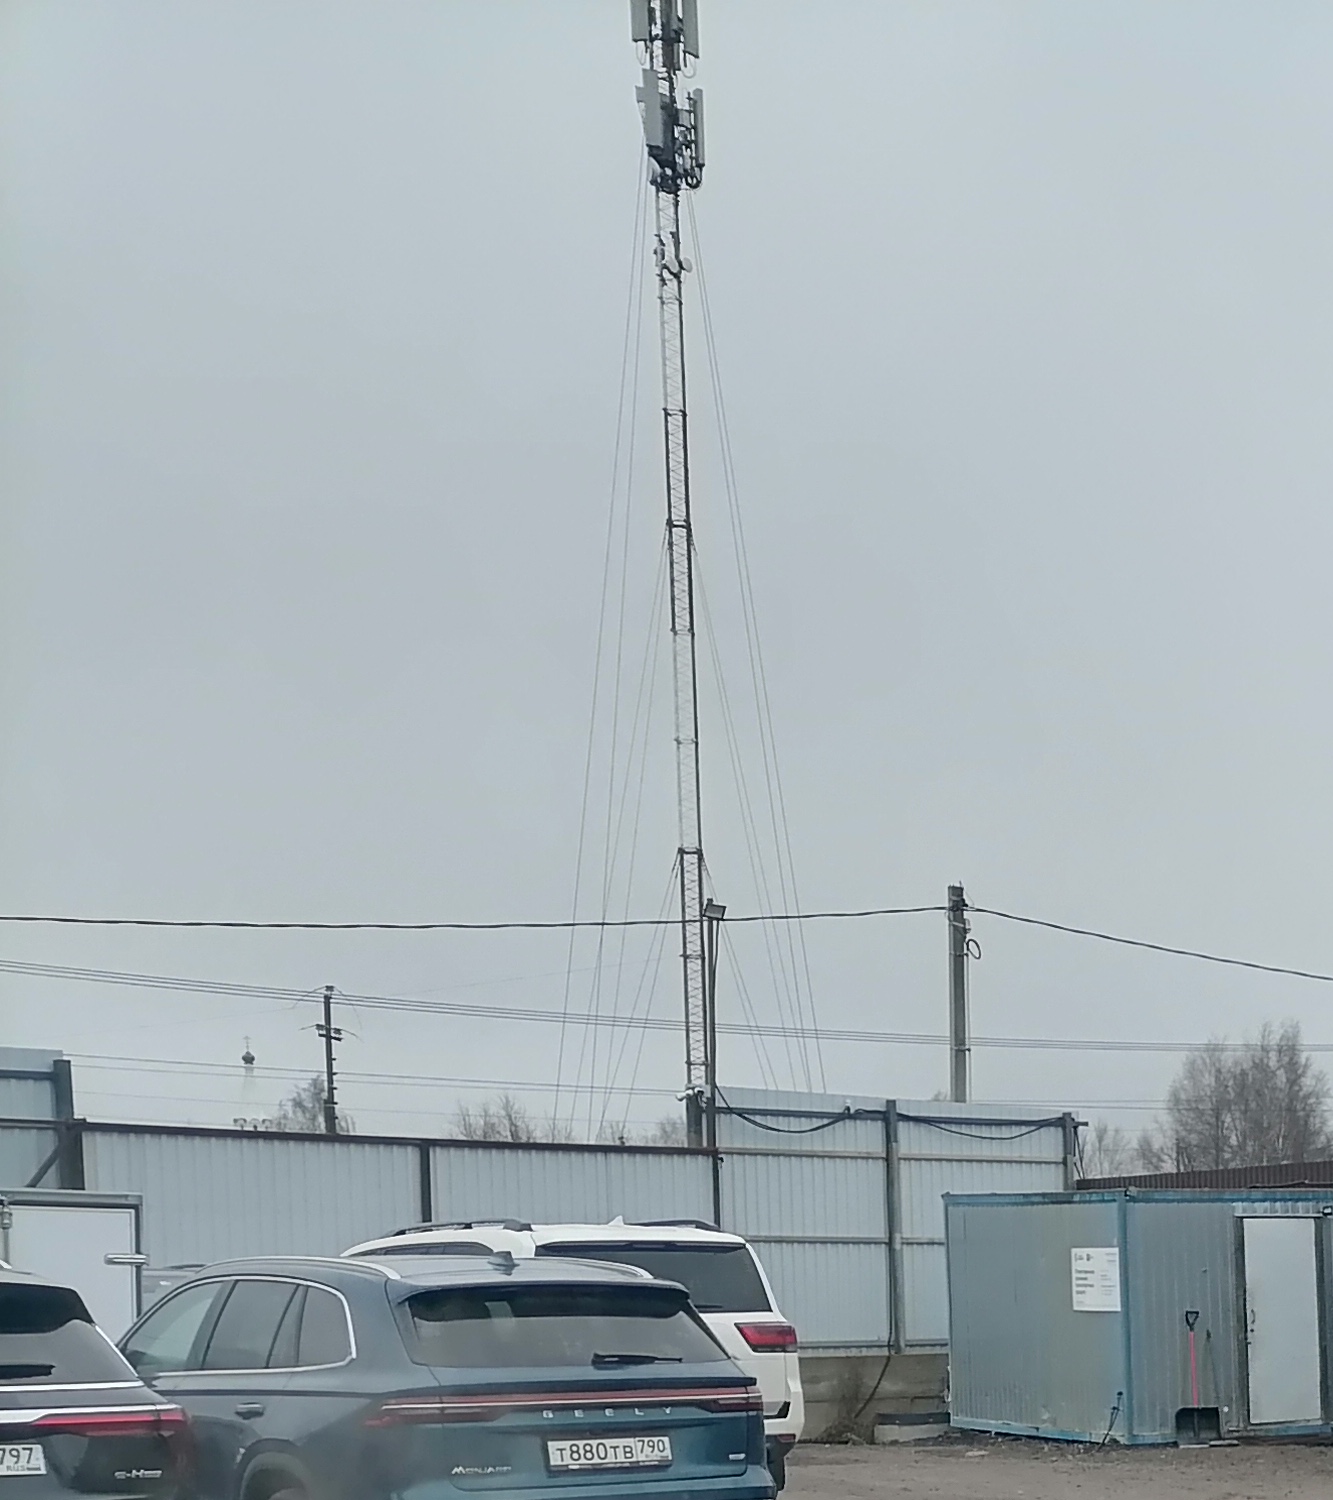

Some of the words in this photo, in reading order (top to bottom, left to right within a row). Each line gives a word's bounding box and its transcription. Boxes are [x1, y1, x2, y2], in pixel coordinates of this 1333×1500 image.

[542, 1406, 672, 1418] GEELY
[637, 1439, 666, 1455] 790
[0, 1447, 33, 1465] 797
